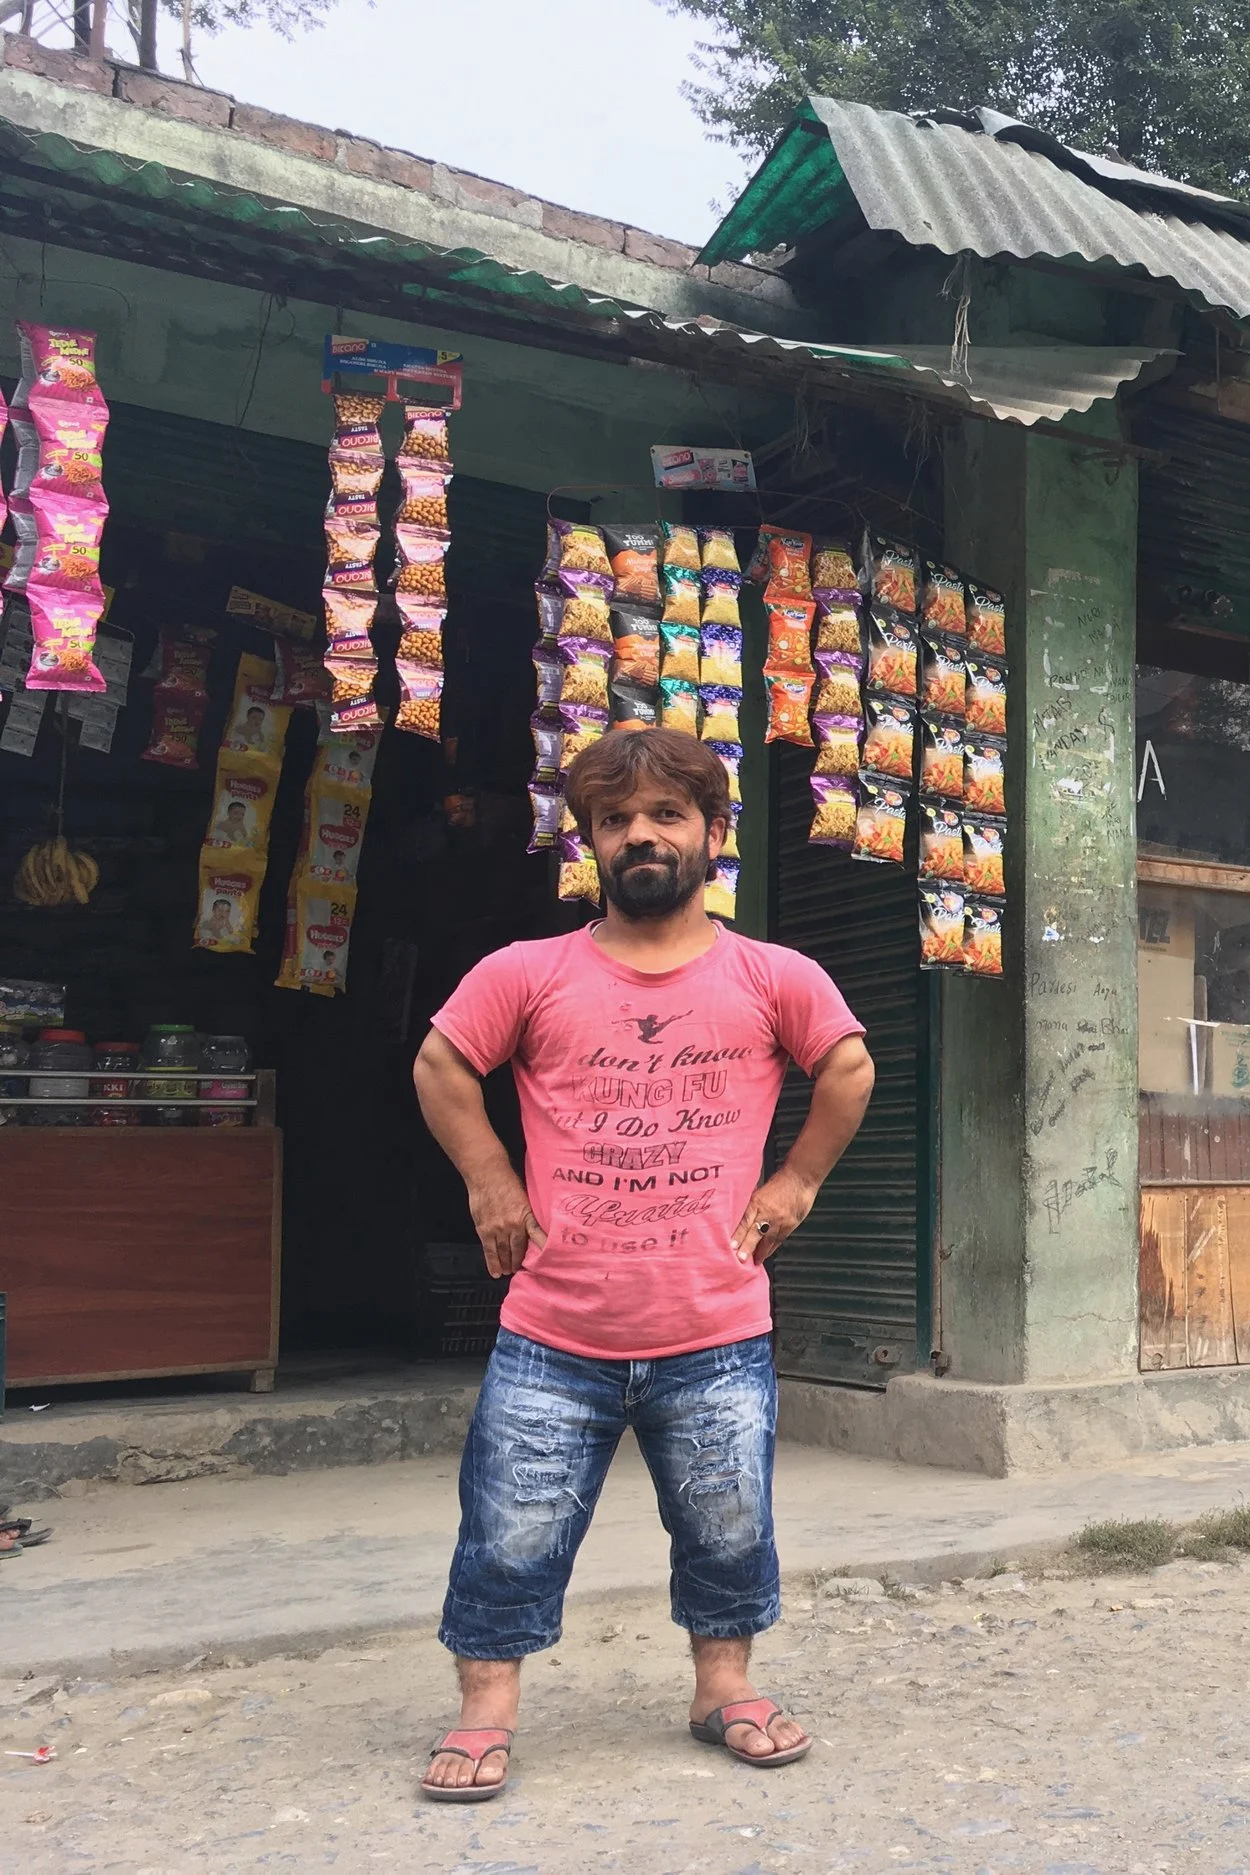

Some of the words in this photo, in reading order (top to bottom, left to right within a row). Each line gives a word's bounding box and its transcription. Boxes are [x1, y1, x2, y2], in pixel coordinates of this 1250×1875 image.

[578, 1047, 664, 1074] don't
[671, 1045, 752, 1069] know
[571, 1075, 673, 1109] KUNG
[682, 1070, 728, 1102] FU
[589, 1112, 608, 1133] I
[616, 1116, 659, 1138] Do
[668, 1108, 741, 1133] Know
[583, 1141, 687, 1170] CRAZY
[552, 1168, 604, 1186] AND
[613, 1176, 656, 1192] I'M
[668, 1165, 724, 1186] NOT
[559, 1188, 716, 1228] Afraid
[561, 1226, 589, 1247] to
[669, 1227, 690, 1247] it
